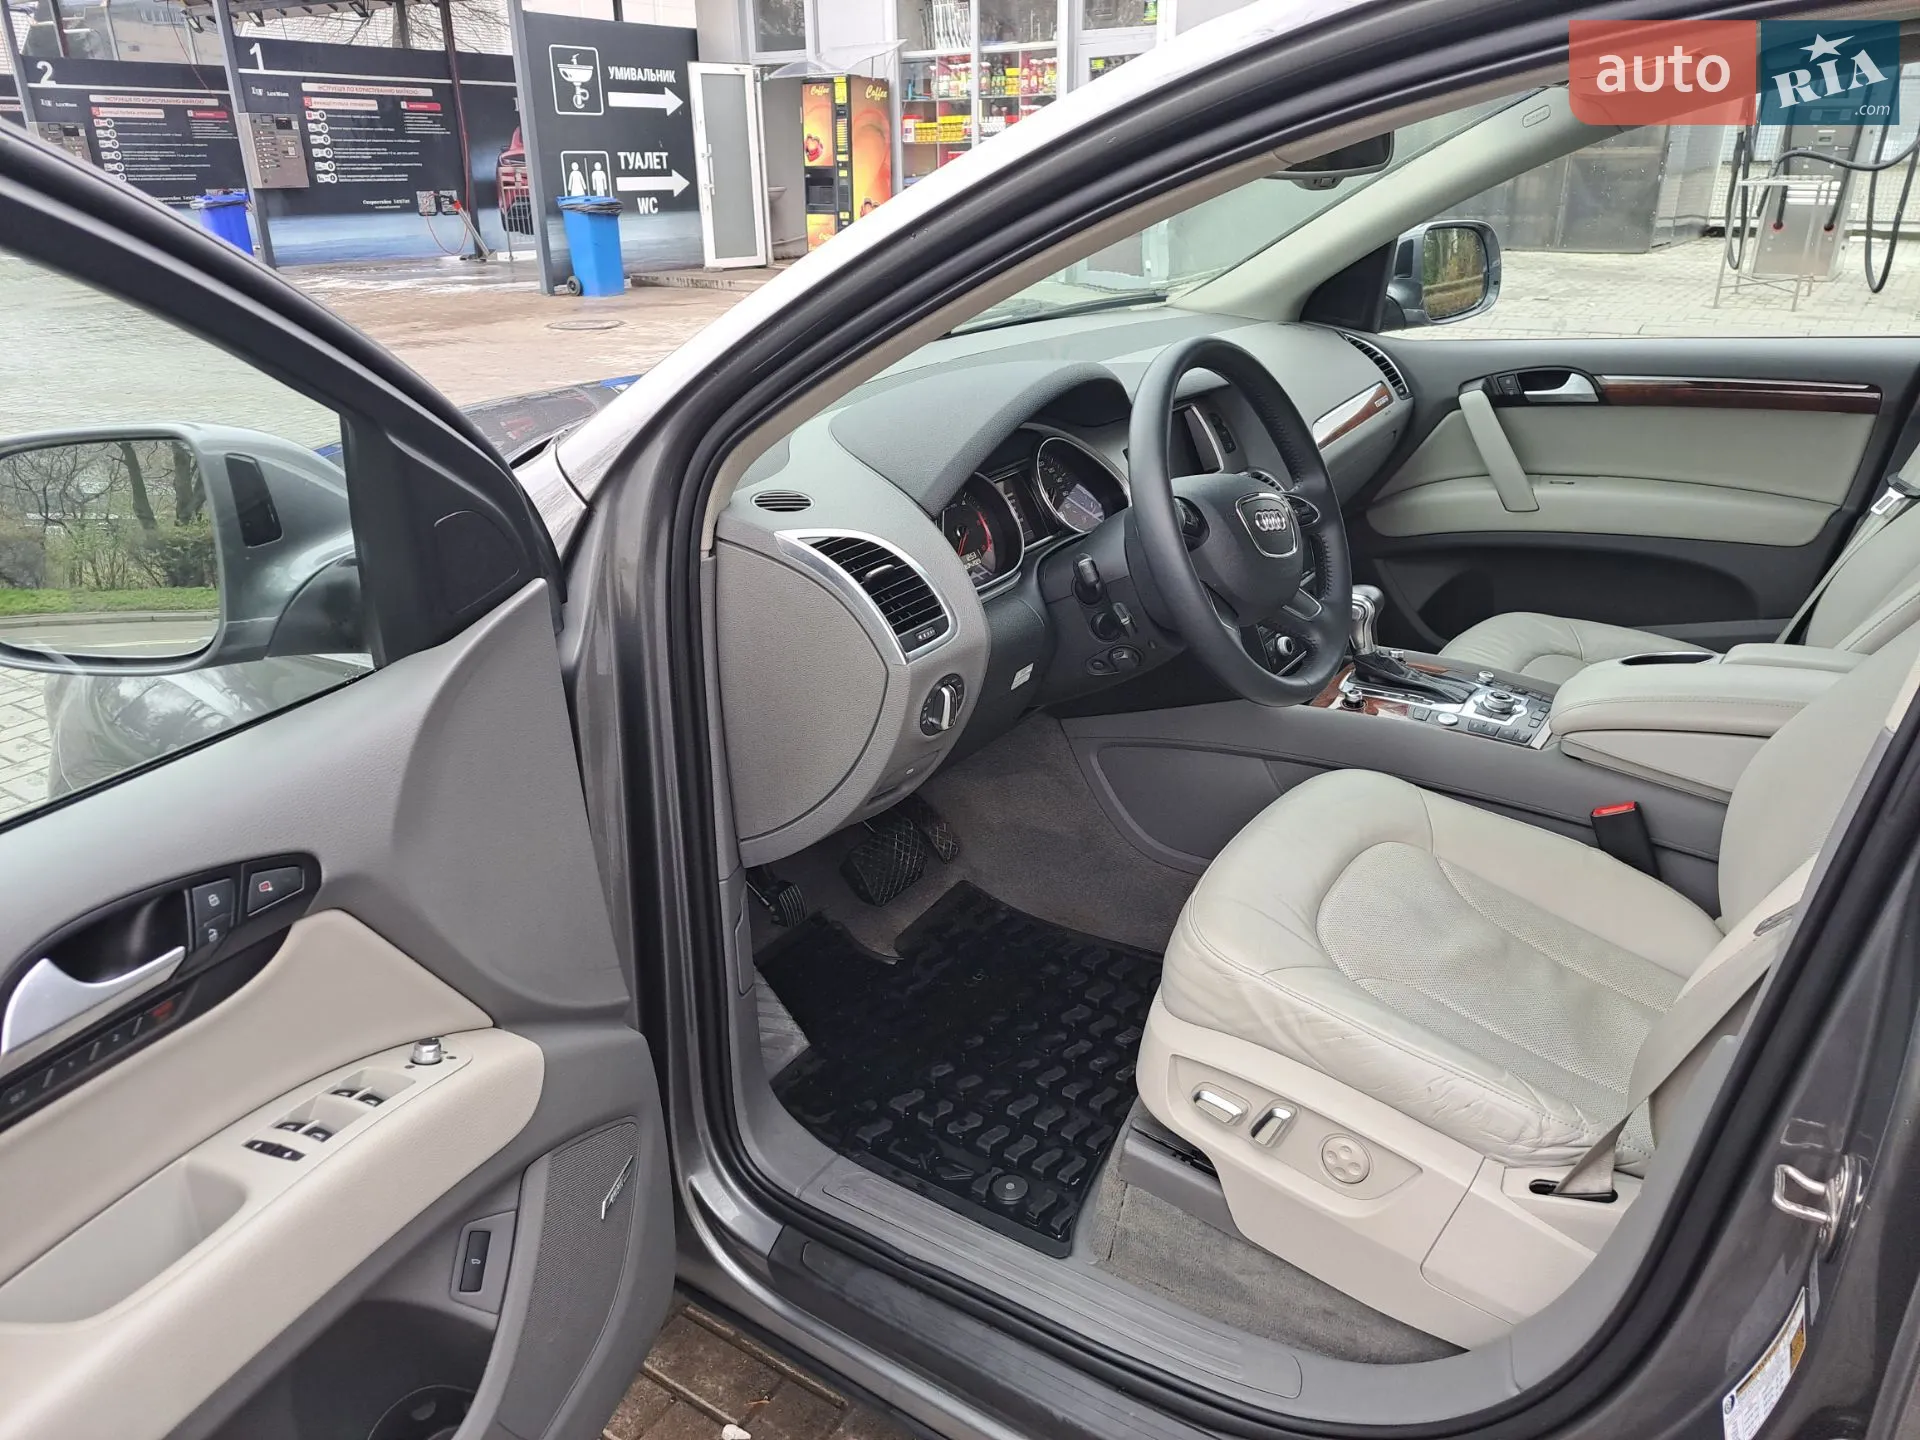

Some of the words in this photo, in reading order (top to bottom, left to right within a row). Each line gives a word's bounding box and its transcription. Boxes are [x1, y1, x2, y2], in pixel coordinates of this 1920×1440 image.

[249, 42, 265, 71] 1
[36, 61, 56, 84] 2
[607, 65, 676, 83] УМИВАЛЬНИК
[810, 85, 830, 96] Coffee
[865, 84, 888, 101] Coffee
[617, 151, 669, 170] ТУАЛЕТ
[636, 196, 659, 215] WC
